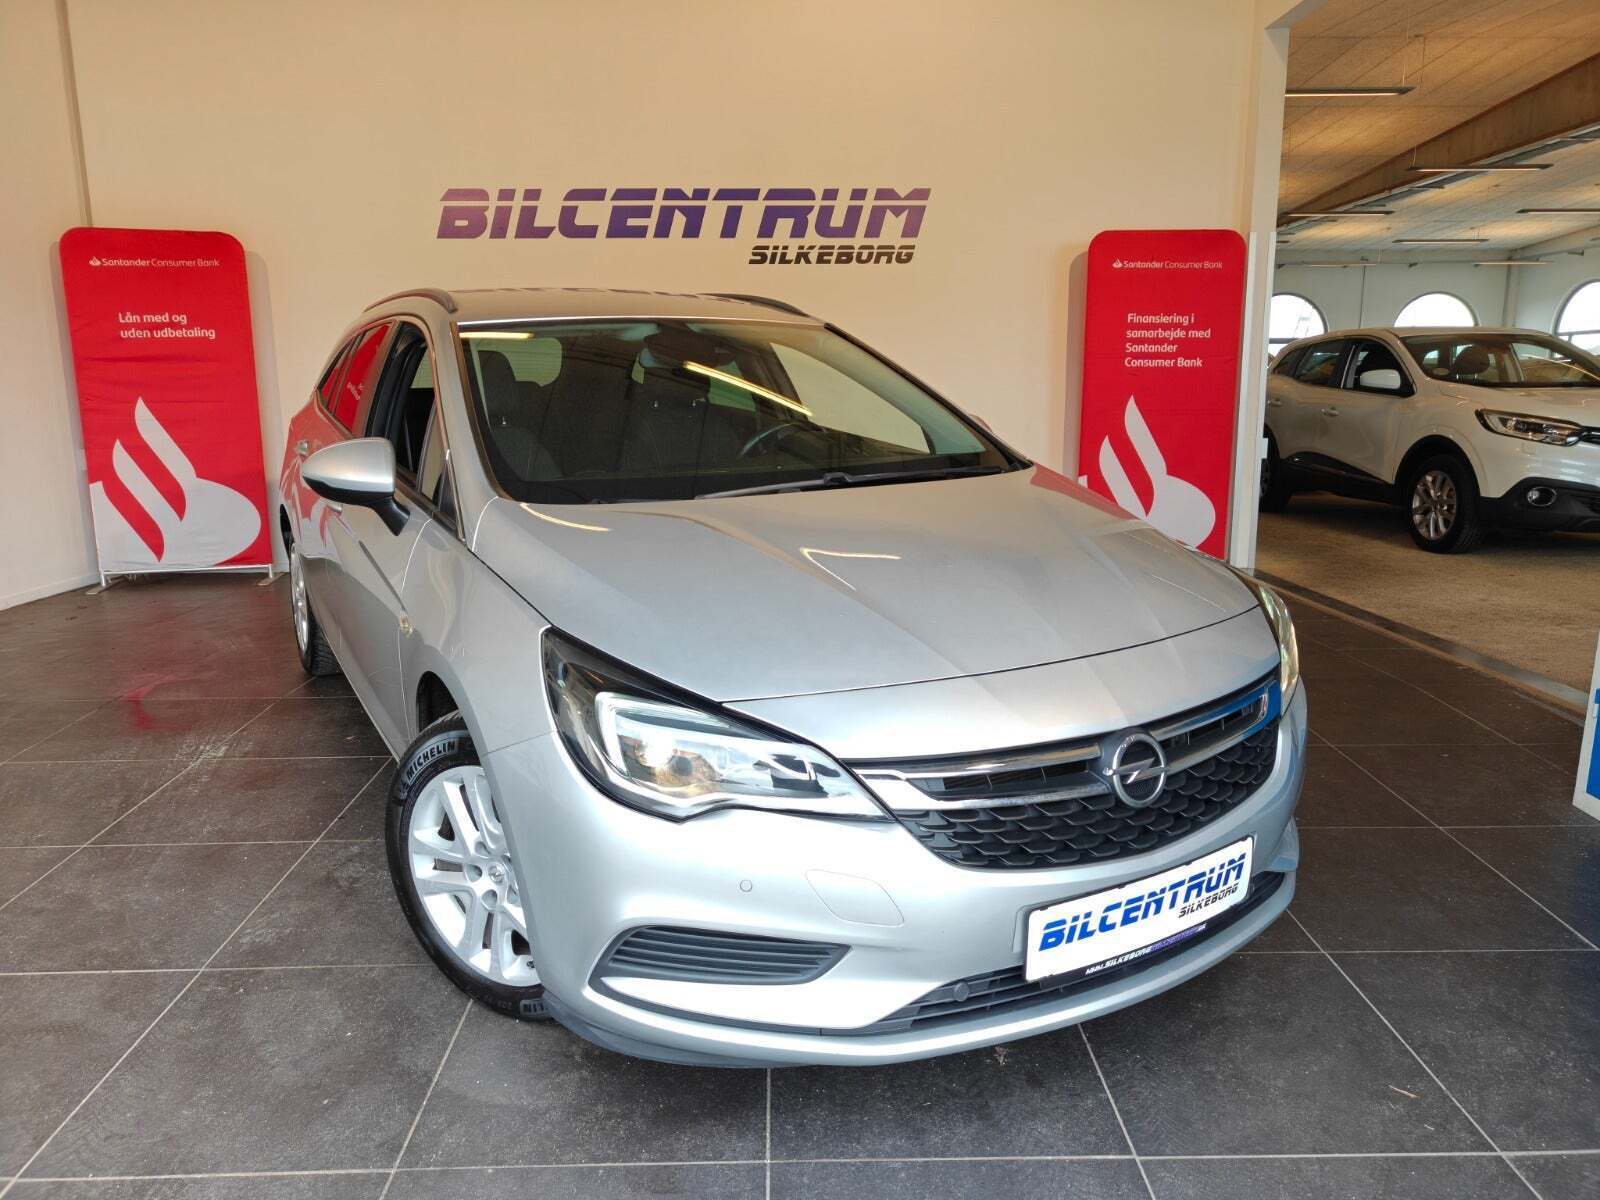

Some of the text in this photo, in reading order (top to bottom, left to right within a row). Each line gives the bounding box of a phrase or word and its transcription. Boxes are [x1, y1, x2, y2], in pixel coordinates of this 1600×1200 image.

[436, 187, 932, 239] BILCENTRUM
[749, 244, 916, 265] SILKEBORG
[102, 258, 220, 267] Santander Consumer Bank
[1123, 260, 1223, 269] Santander Consumer Bank
[118, 312, 188, 325] Lån med og
[1127, 313, 1195, 326] Finansiering i
[120, 327, 216, 340] uden udbetaling
[1126, 328, 1211, 341] samarbejde med
[1125, 342, 1178, 353] Santander
[1124, 357, 1203, 367] Consumer Bank
[406, 740, 456, 780] MICHELIN
[1038, 852, 1246, 952] BILCENTRUM
[1178, 882, 1240, 919] SILKEBORG
